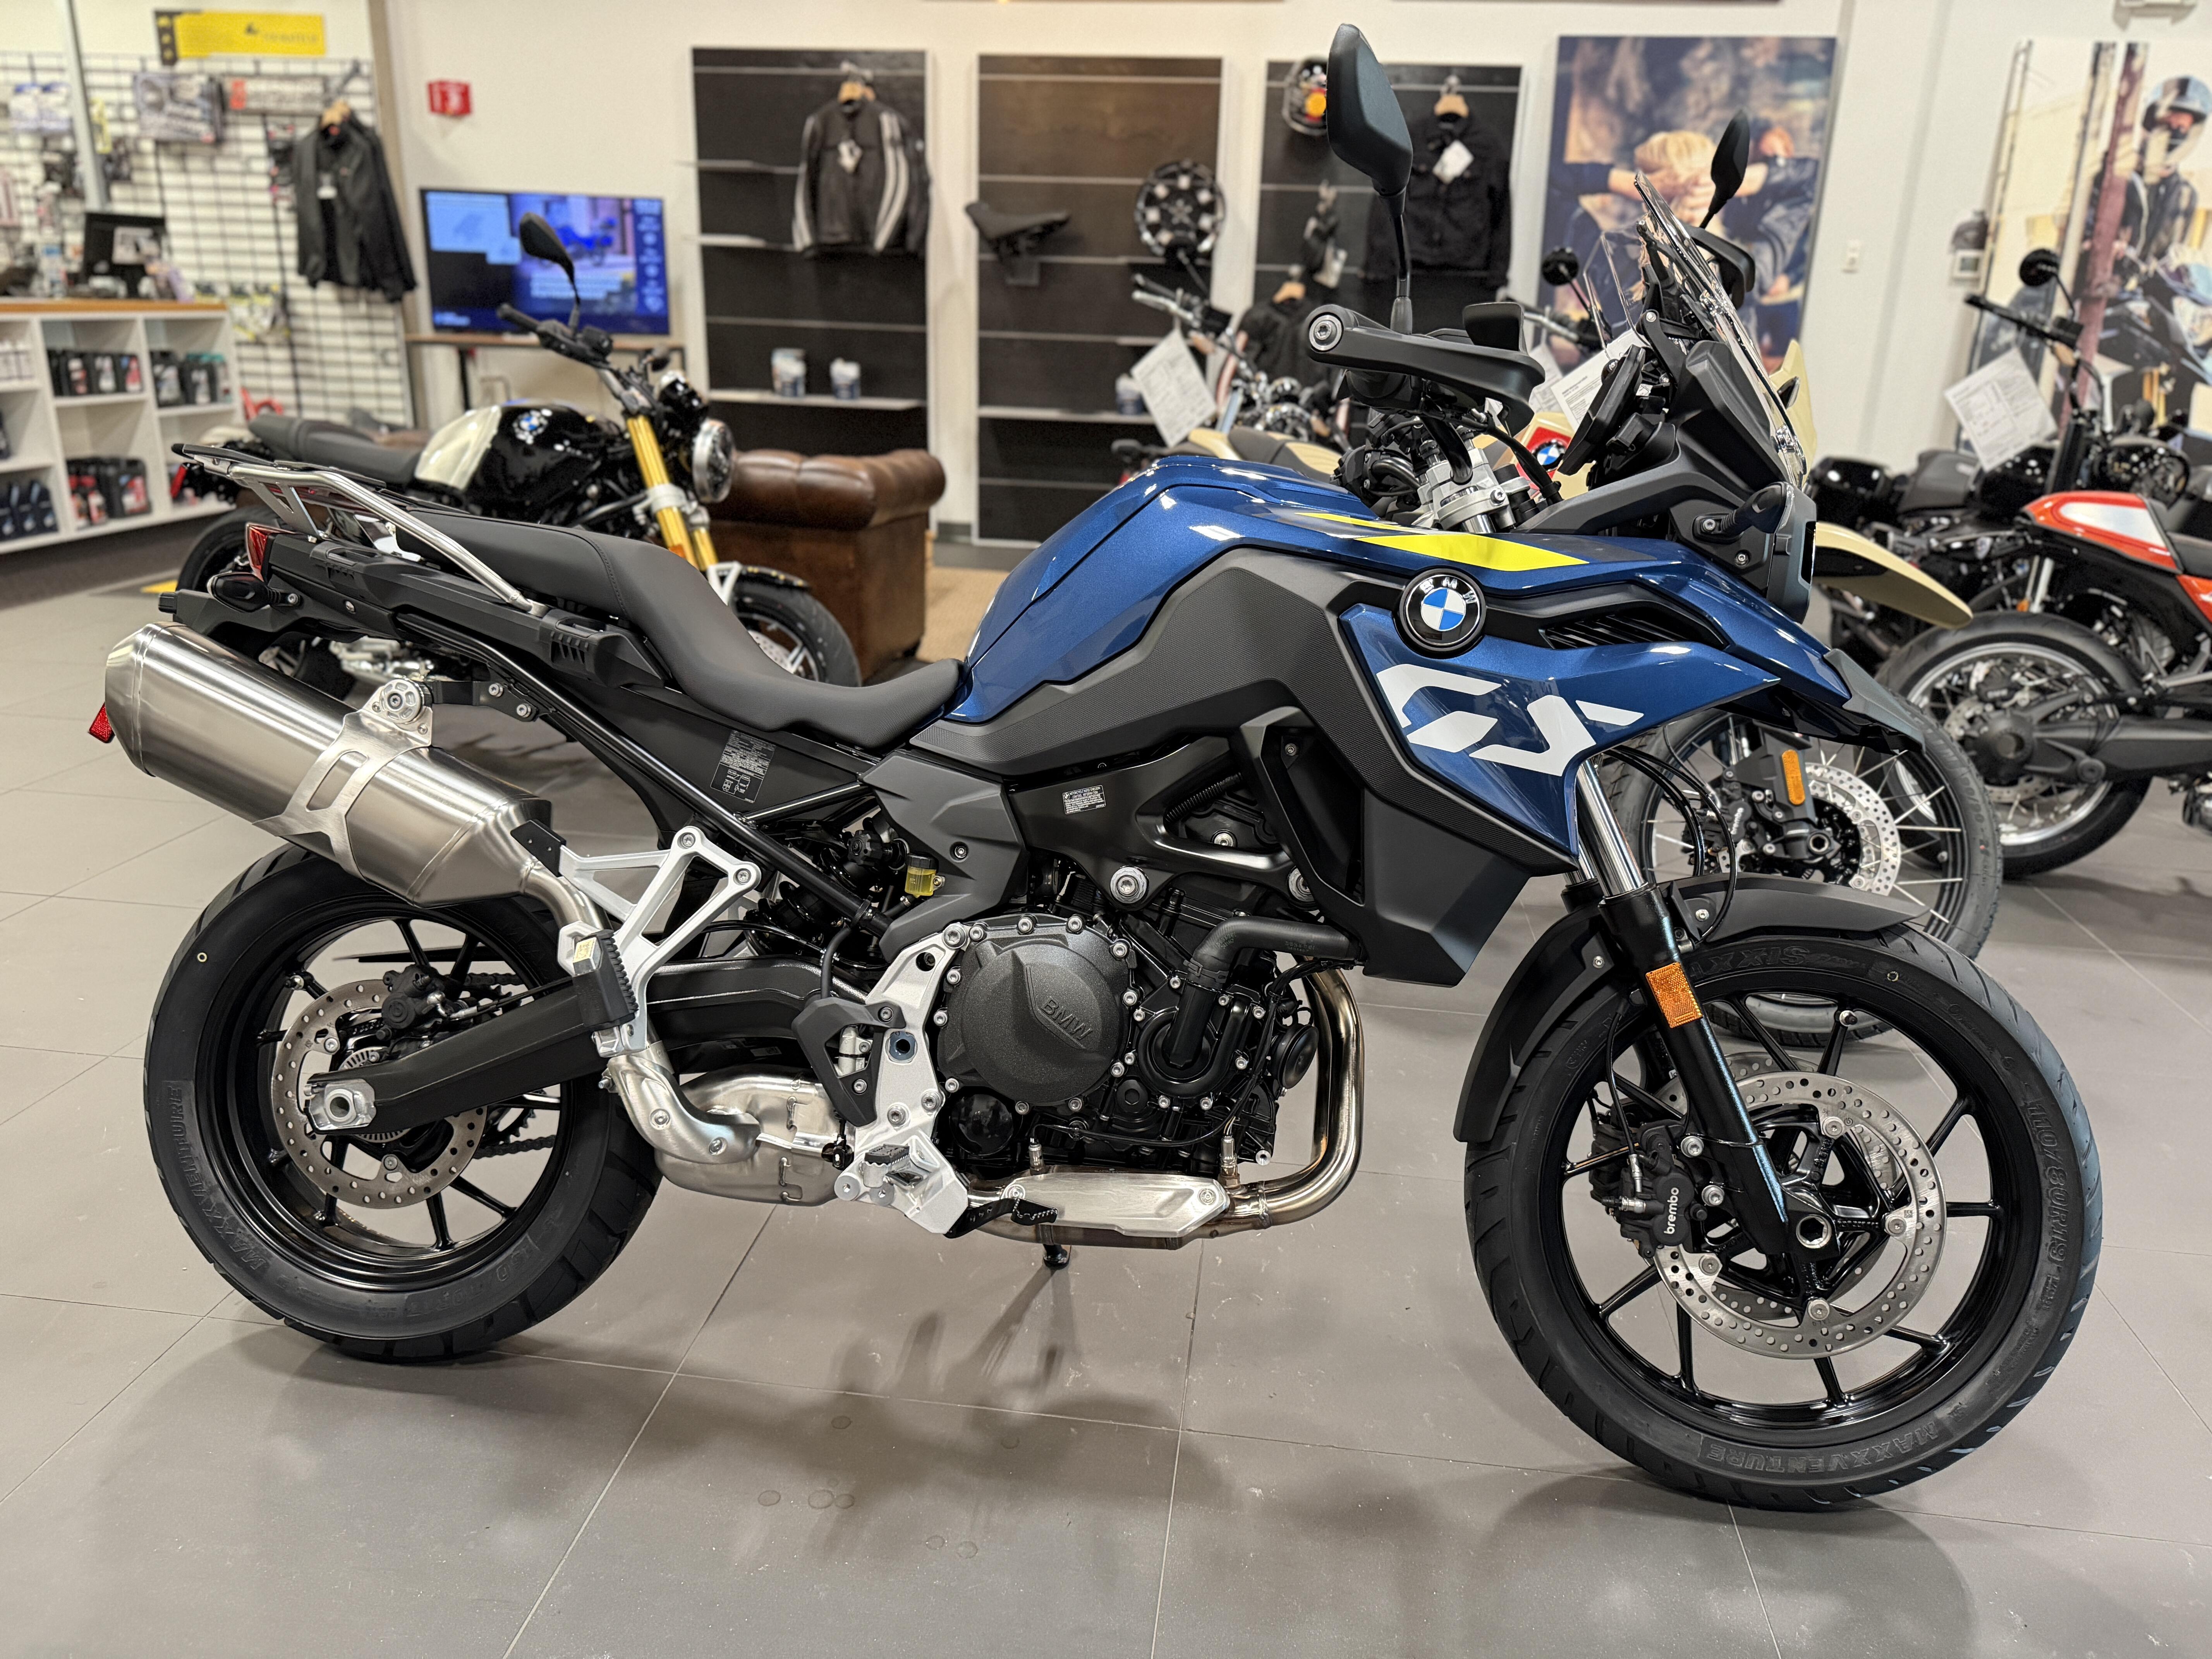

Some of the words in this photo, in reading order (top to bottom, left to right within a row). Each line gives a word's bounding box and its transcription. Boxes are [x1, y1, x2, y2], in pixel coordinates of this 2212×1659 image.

[1419, 577, 1477, 604] BMW
[1376, 664, 1644, 776] GS
[1730, 807, 1744, 835] brembo
[1041, 996, 1093, 1040] BMW
[2028, 1104, 2069, 1262] 110/80R19
[1664, 1187, 1679, 1234] brembo
[1707, 1421, 1938, 1473] MAXXVENTURE
